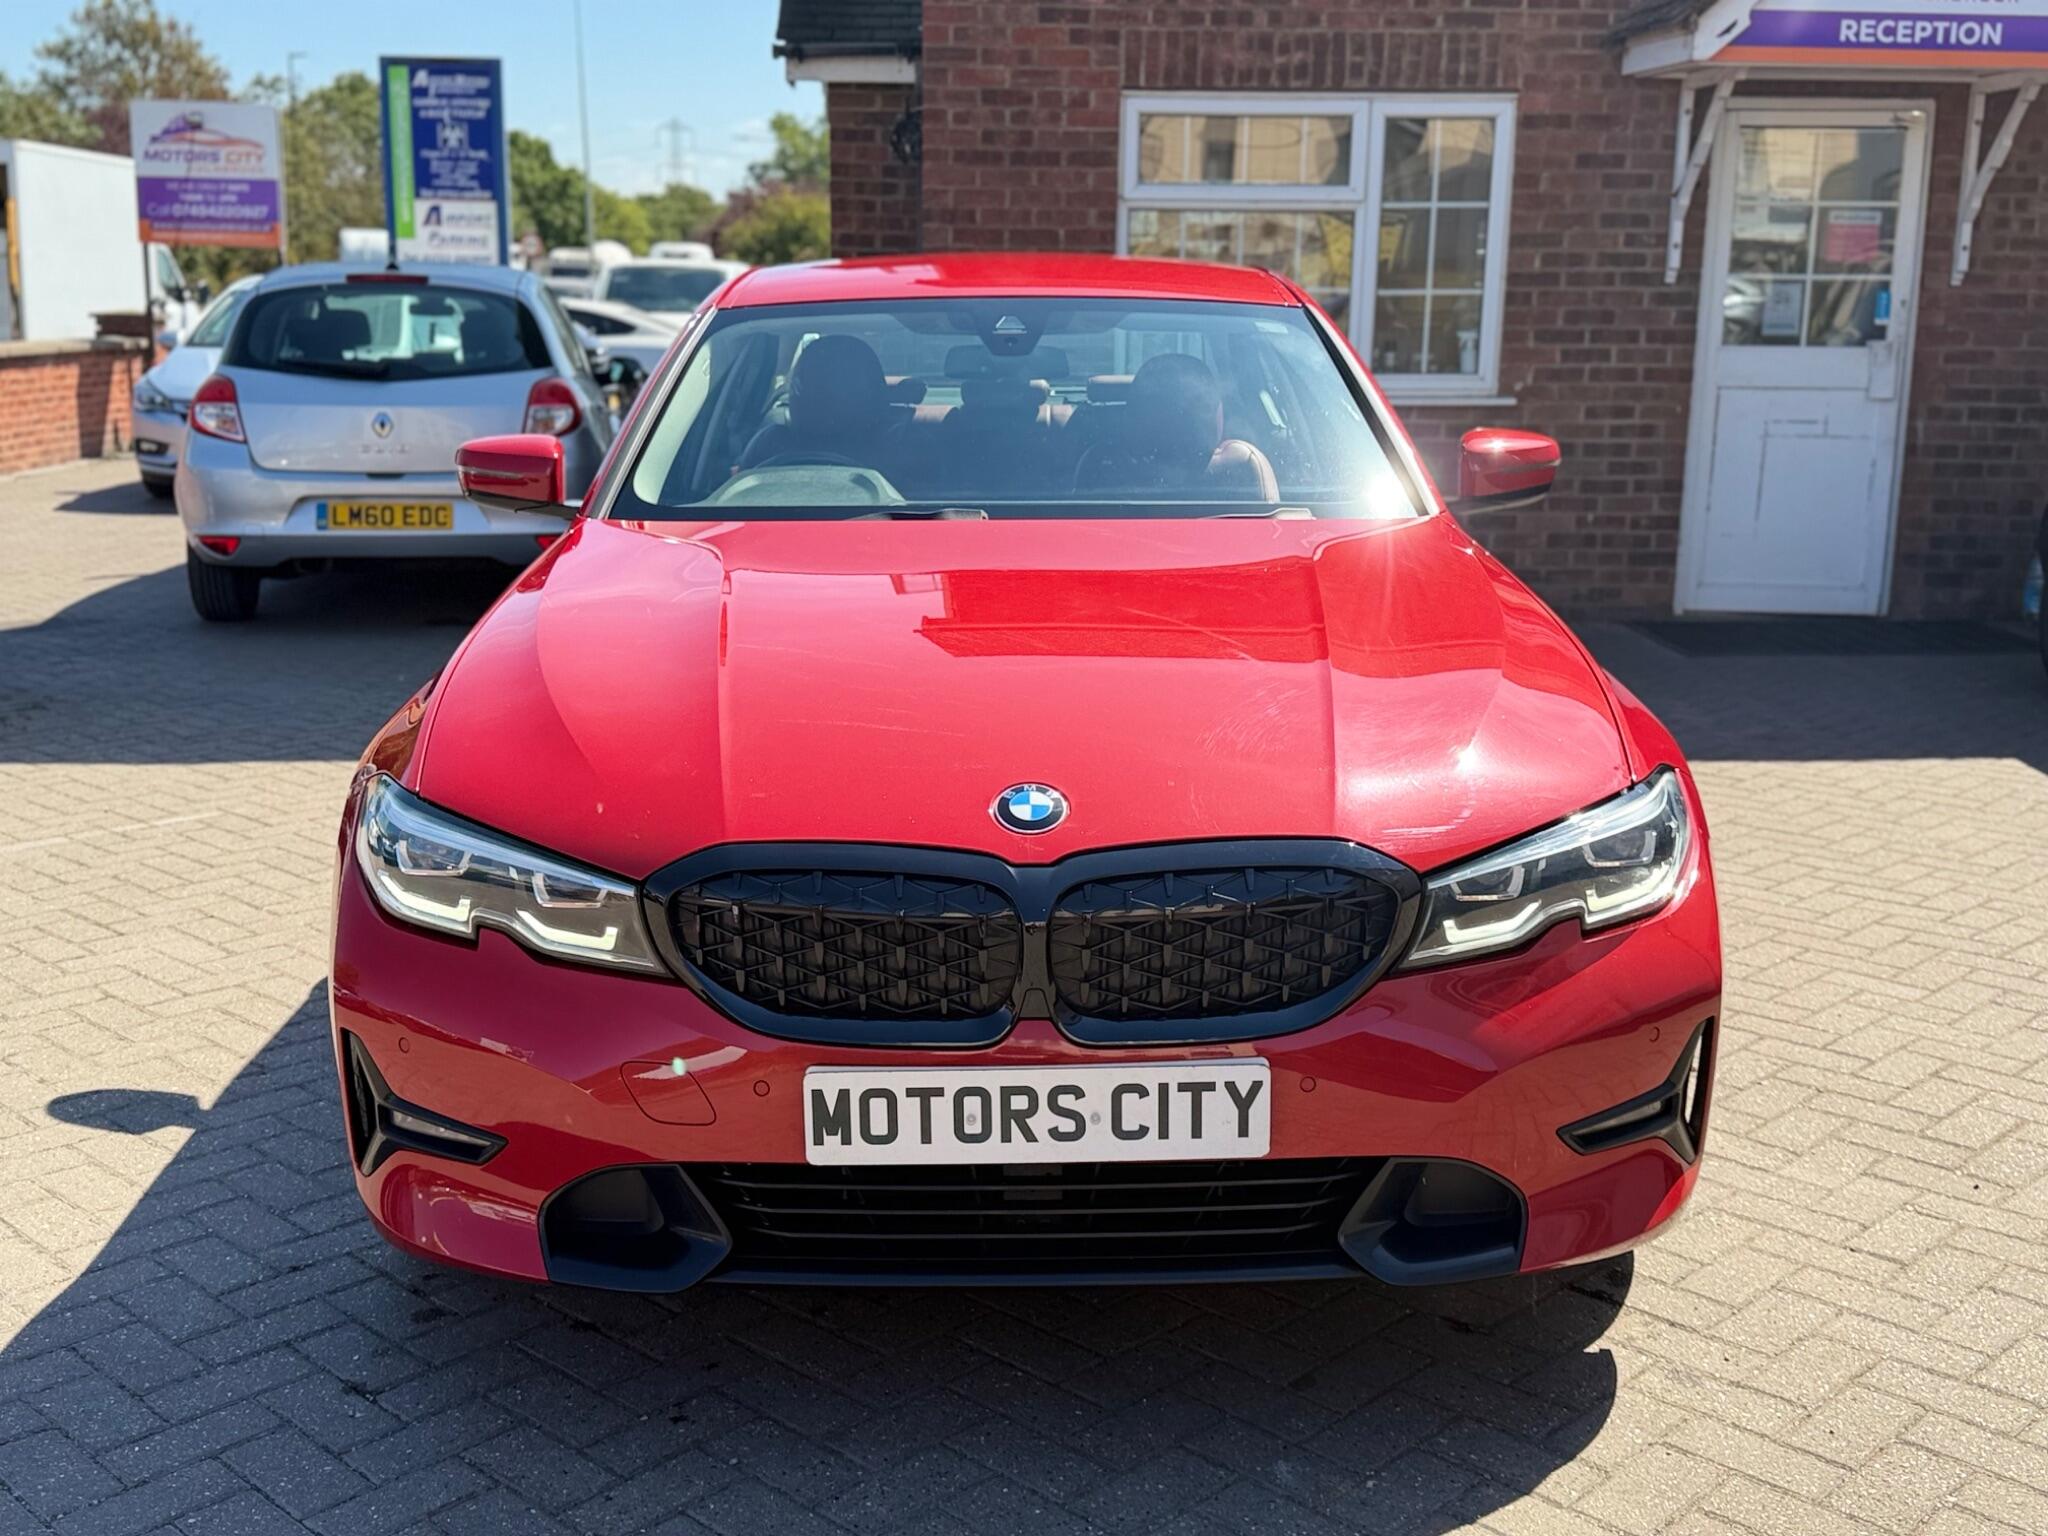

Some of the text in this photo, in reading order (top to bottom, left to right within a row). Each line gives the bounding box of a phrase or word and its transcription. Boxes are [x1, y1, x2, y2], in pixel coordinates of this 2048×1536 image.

[1839, 19, 2003, 45] RECEPTION
[143, 149, 265, 163] MOTORS CITY
[332, 504, 395, 526] LM60
[1003, 784, 1061, 799] BMW
[811, 1079, 1264, 1146] MOTORS CITY
